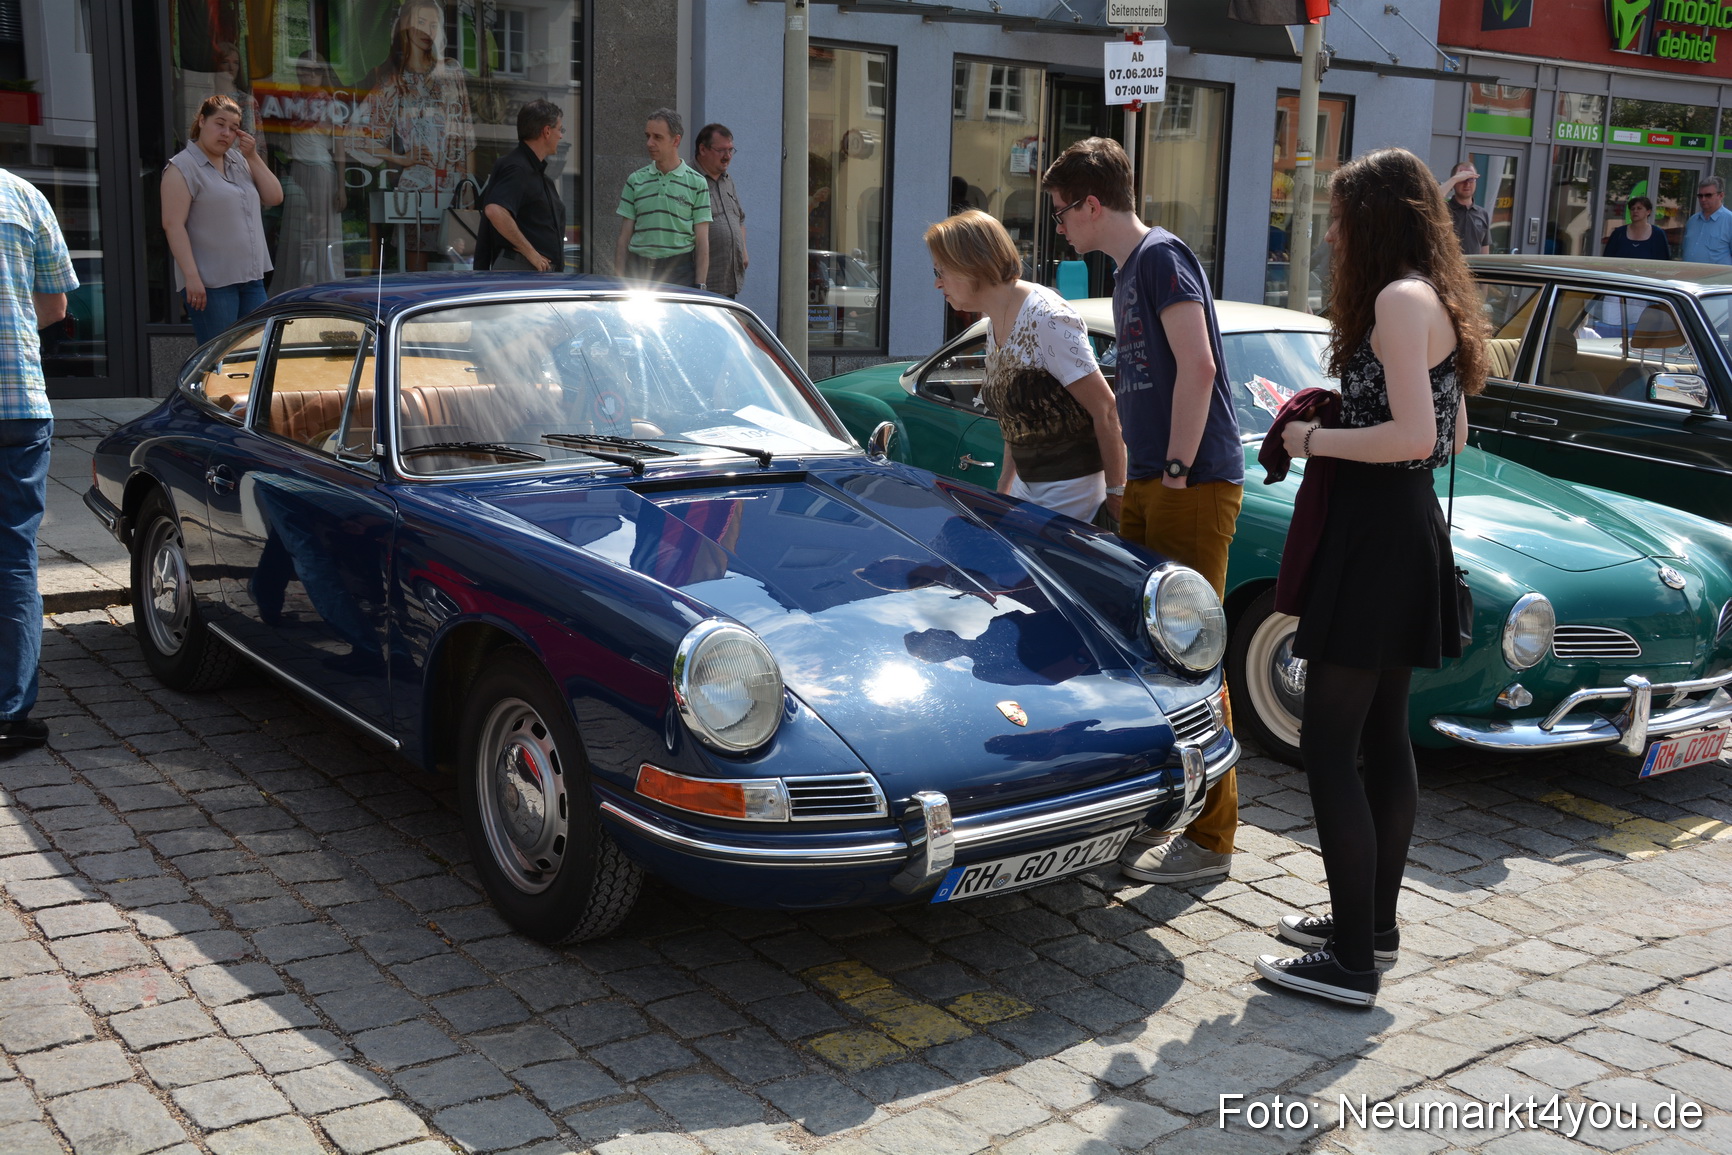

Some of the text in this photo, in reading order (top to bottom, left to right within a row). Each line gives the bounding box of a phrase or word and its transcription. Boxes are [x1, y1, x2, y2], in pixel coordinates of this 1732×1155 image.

[1111, 4, 1163, 17] Seitenstreifen
[1131, 52, 1144, 62] Ab
[1658, 29, 1717, 63] debitel
[1109, 67, 1164, 80] 07.06.2015
[1115, 85, 1159, 96] 07:00 Uhr
[332, 90, 463, 125] SUMMER
[332, 122, 465, 162] FEELING
[1558, 123, 1598, 141] GRAVIS
[1652, 742, 1680, 771] RH
[1684, 732, 1726, 763] 0701
[939, 888, 949, 897] D
[953, 863, 1003, 896] RH
[1014, 851, 1058, 883] GO
[1056, 830, 1132, 873] 912H
